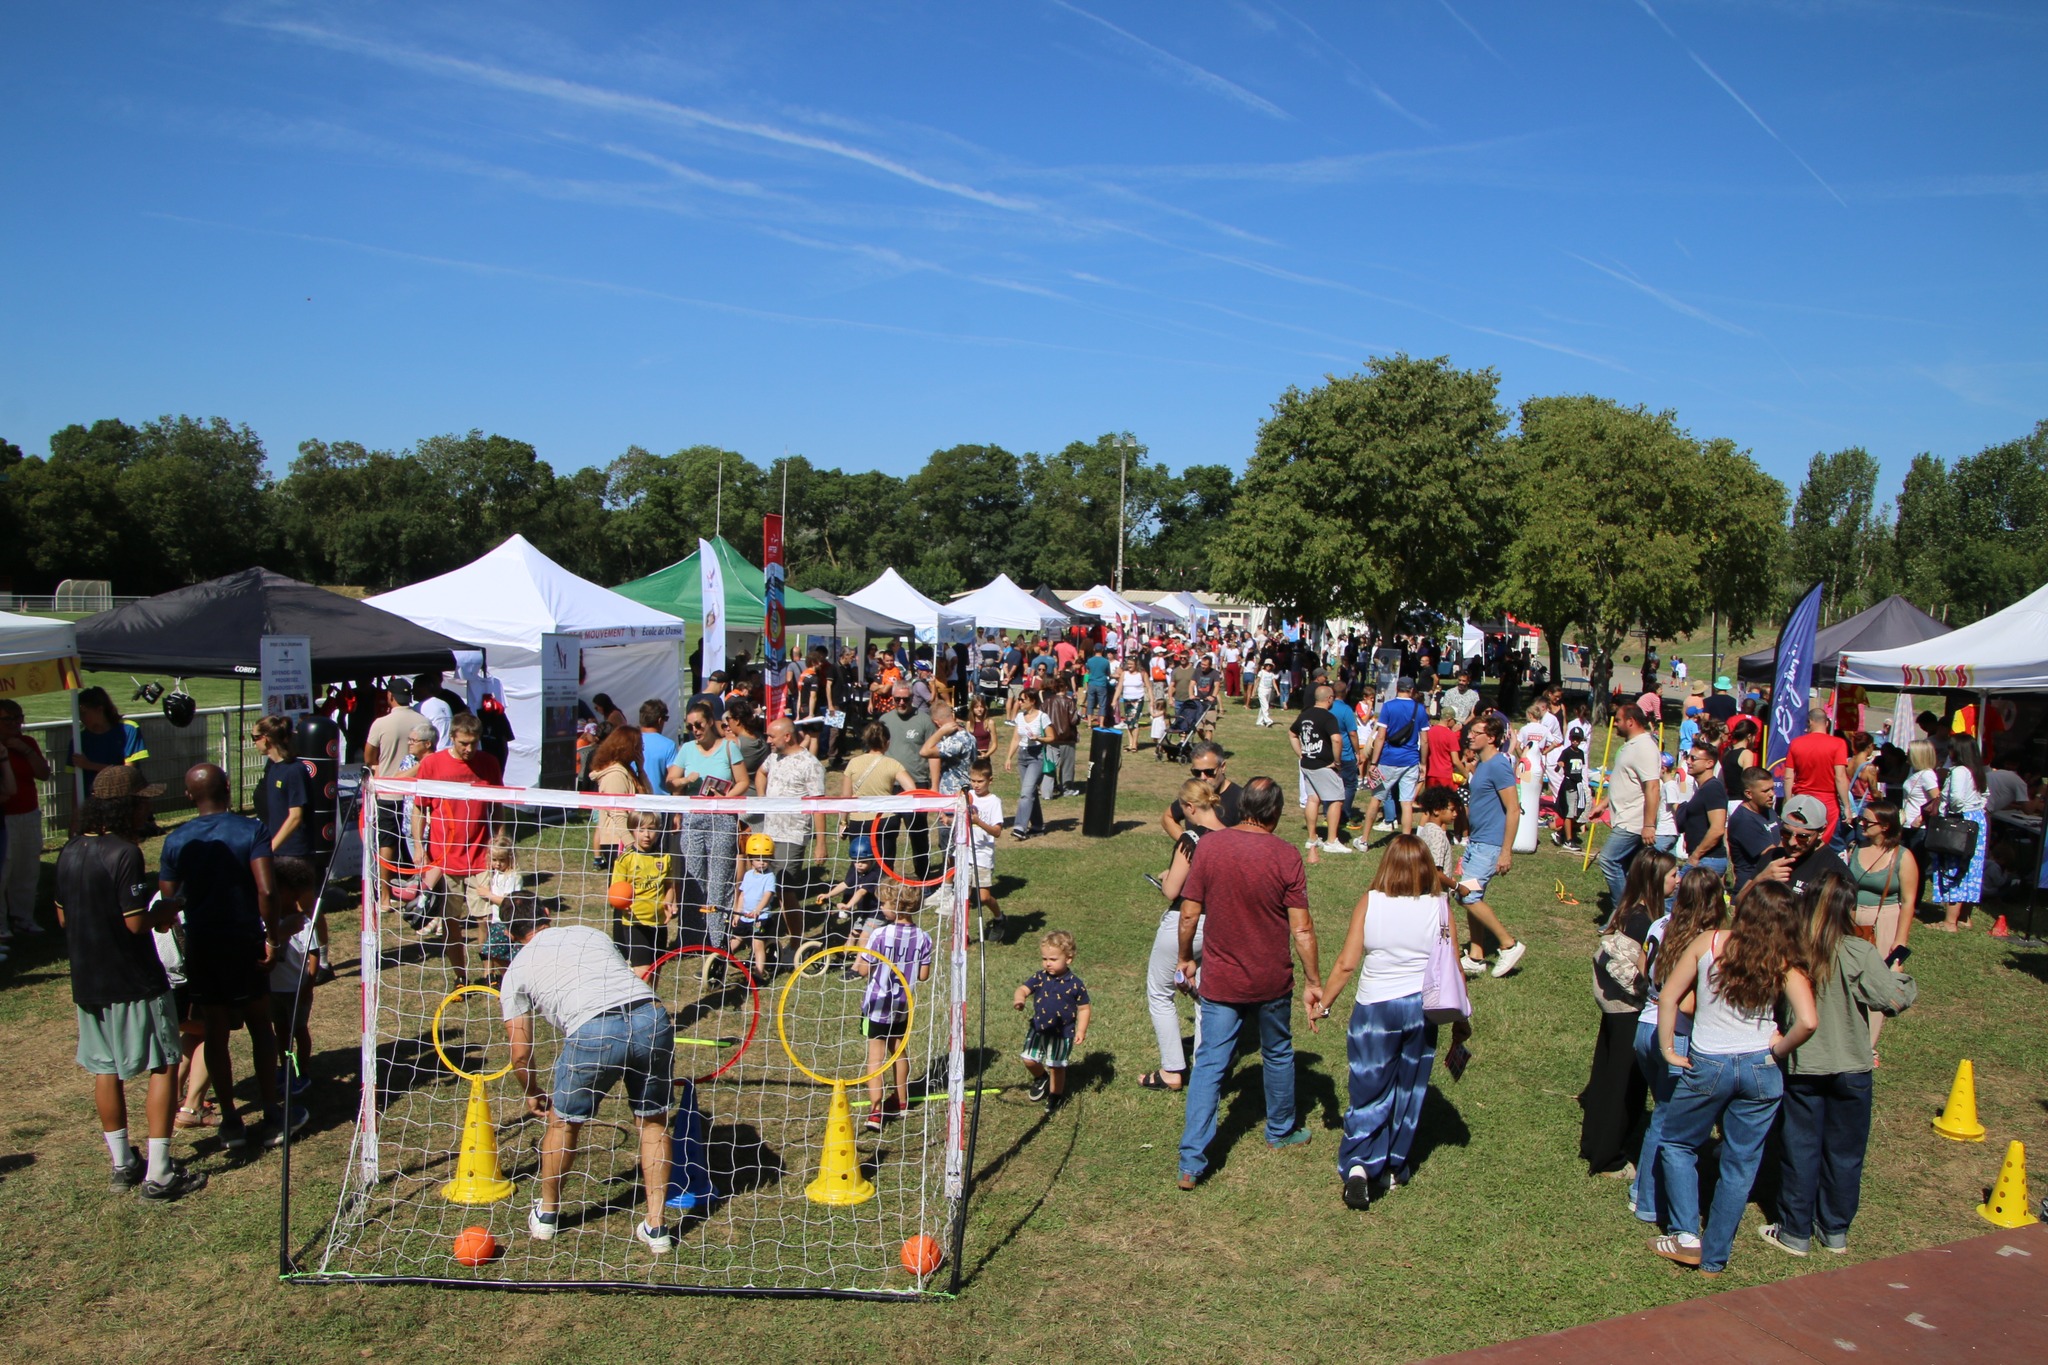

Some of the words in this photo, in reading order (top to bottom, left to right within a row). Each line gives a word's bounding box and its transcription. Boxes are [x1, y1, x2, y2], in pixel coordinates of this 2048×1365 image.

[584, 628, 624, 639] MOUVEMENT
[642, 625, 656, 636] École
[657, 627, 664, 636] de
